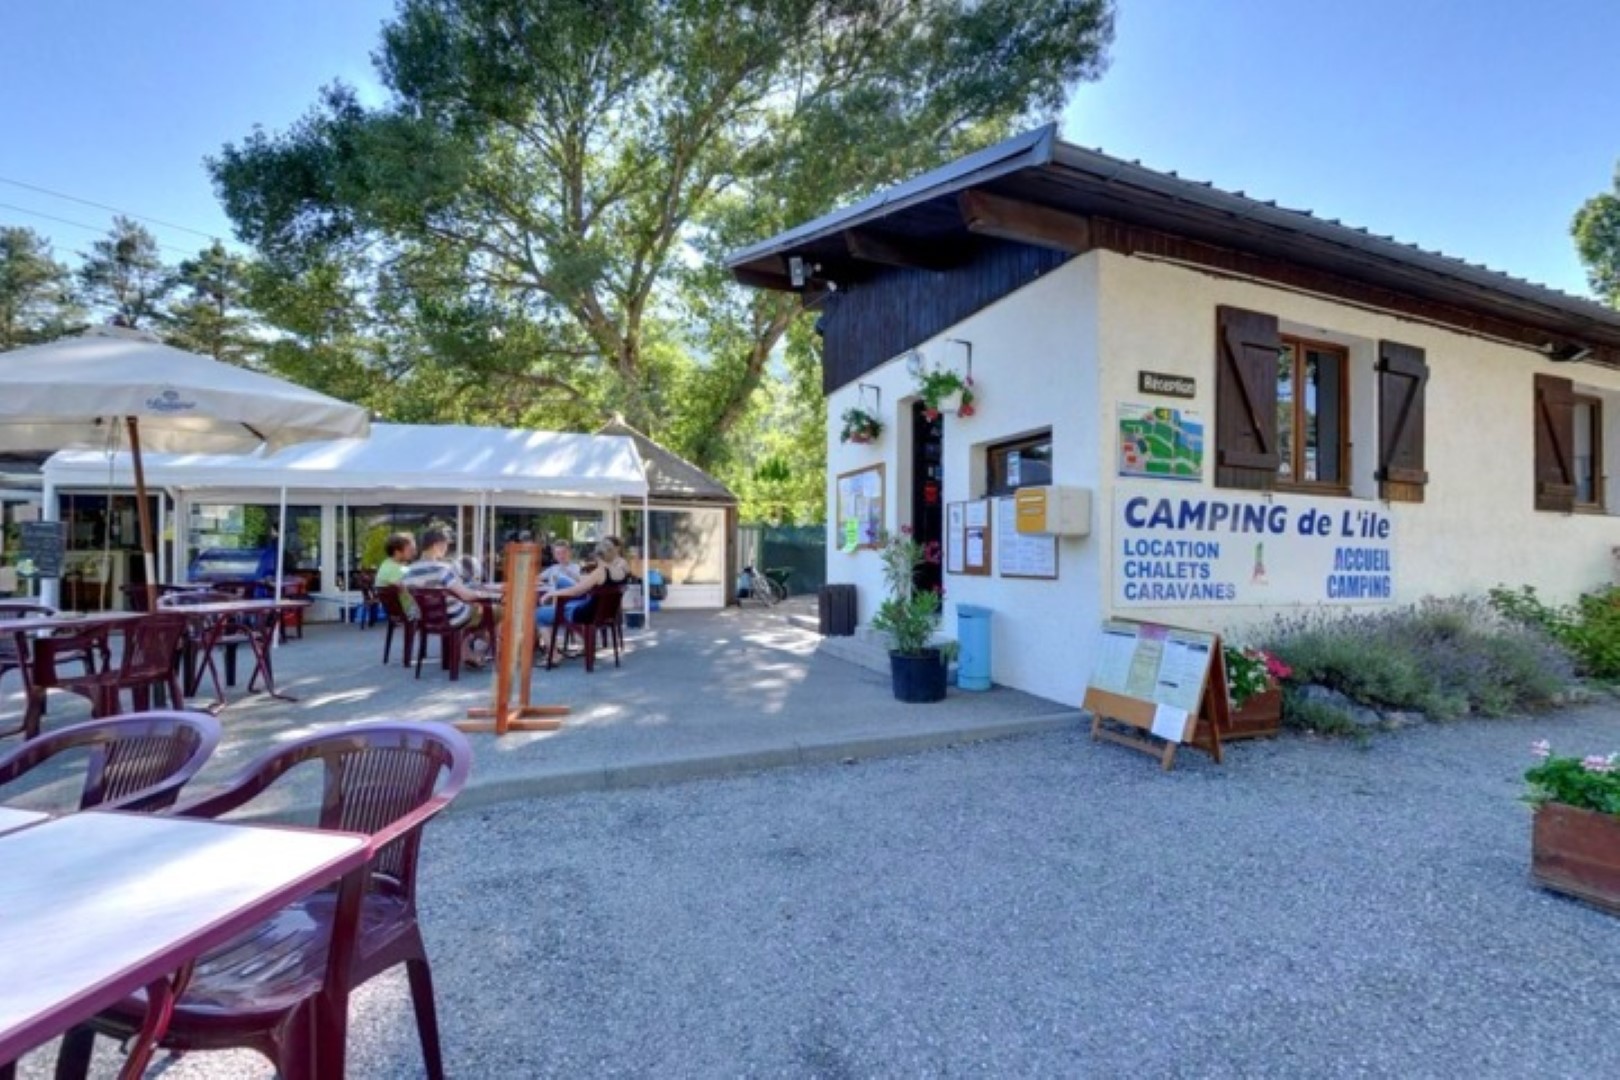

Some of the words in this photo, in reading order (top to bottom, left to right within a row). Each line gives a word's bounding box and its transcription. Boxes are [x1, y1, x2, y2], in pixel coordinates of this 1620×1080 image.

[1124, 496, 1288, 533] CAMPING
[1297, 508, 1332, 536] de
[1124, 539, 1220, 559] LOCATION
[1334, 547, 1391, 573] ACCUEIL
[1124, 561, 1210, 579] CHALETS
[1124, 583, 1236, 600] CARAVANES
[1327, 574, 1391, 599] CAMPING
